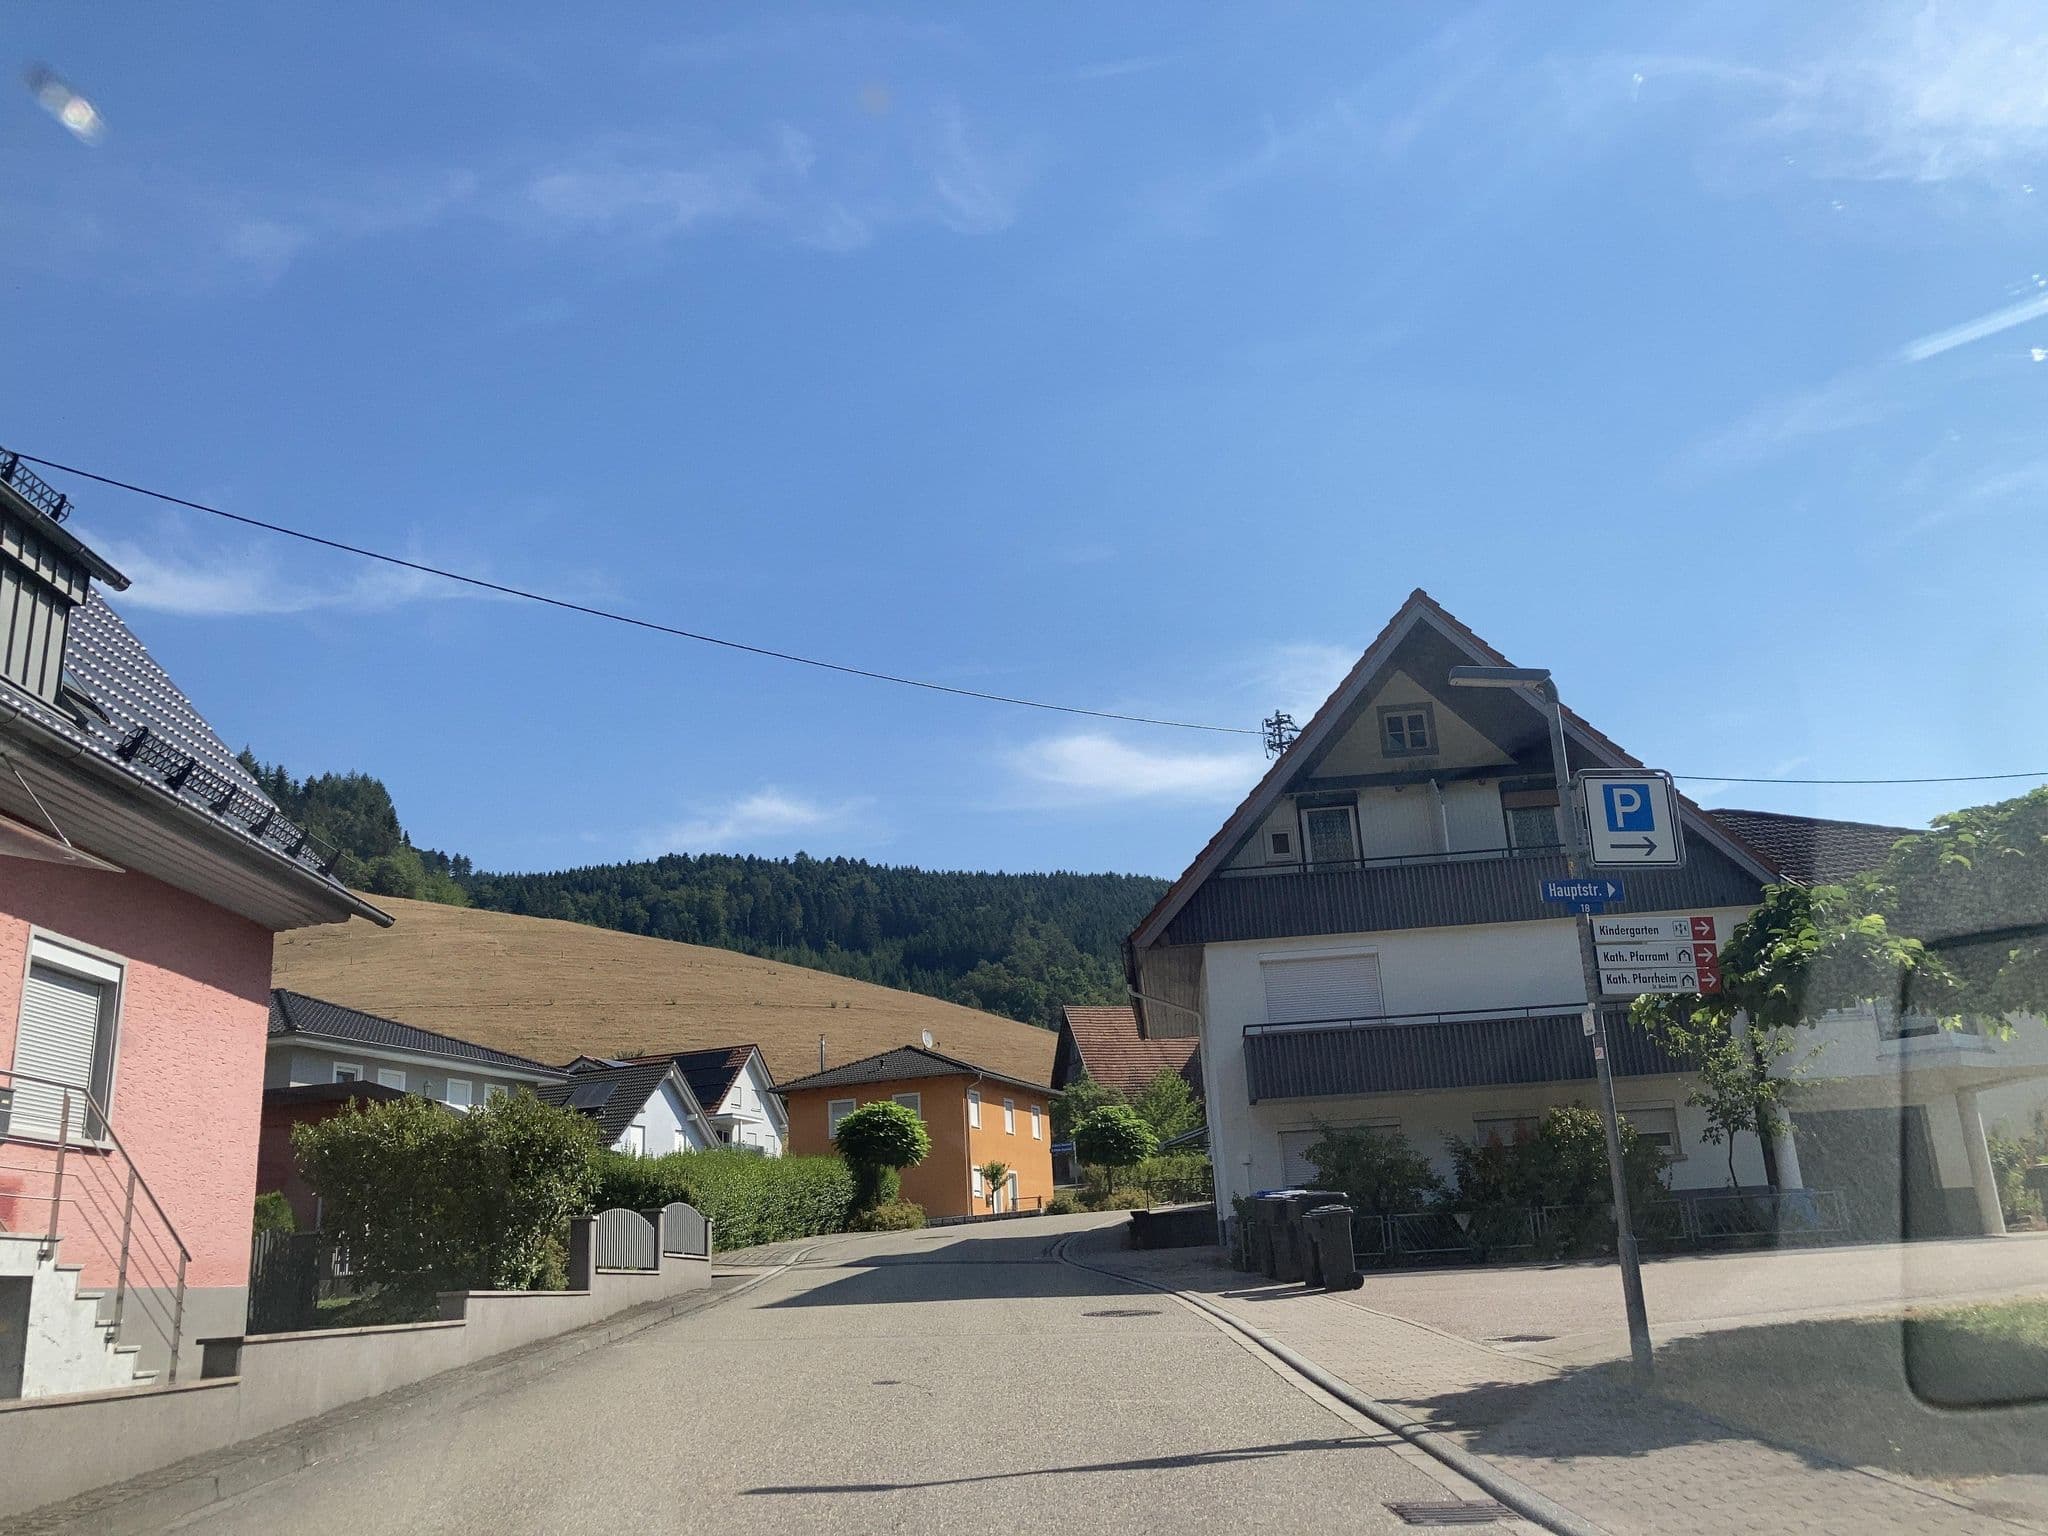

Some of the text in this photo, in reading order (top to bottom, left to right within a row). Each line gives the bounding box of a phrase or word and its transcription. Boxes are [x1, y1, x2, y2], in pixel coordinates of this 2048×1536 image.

[1612, 788, 1642, 828] P
[1548, 882, 1602, 900] Hauptstr.
[1580, 903, 1591, 913] 18
[1599, 924, 1659, 938] Kindergarten
[1603, 950, 1669, 962] Kath. Pfarramt
[1606, 972, 1677, 985] Kath. Pfarrheim
